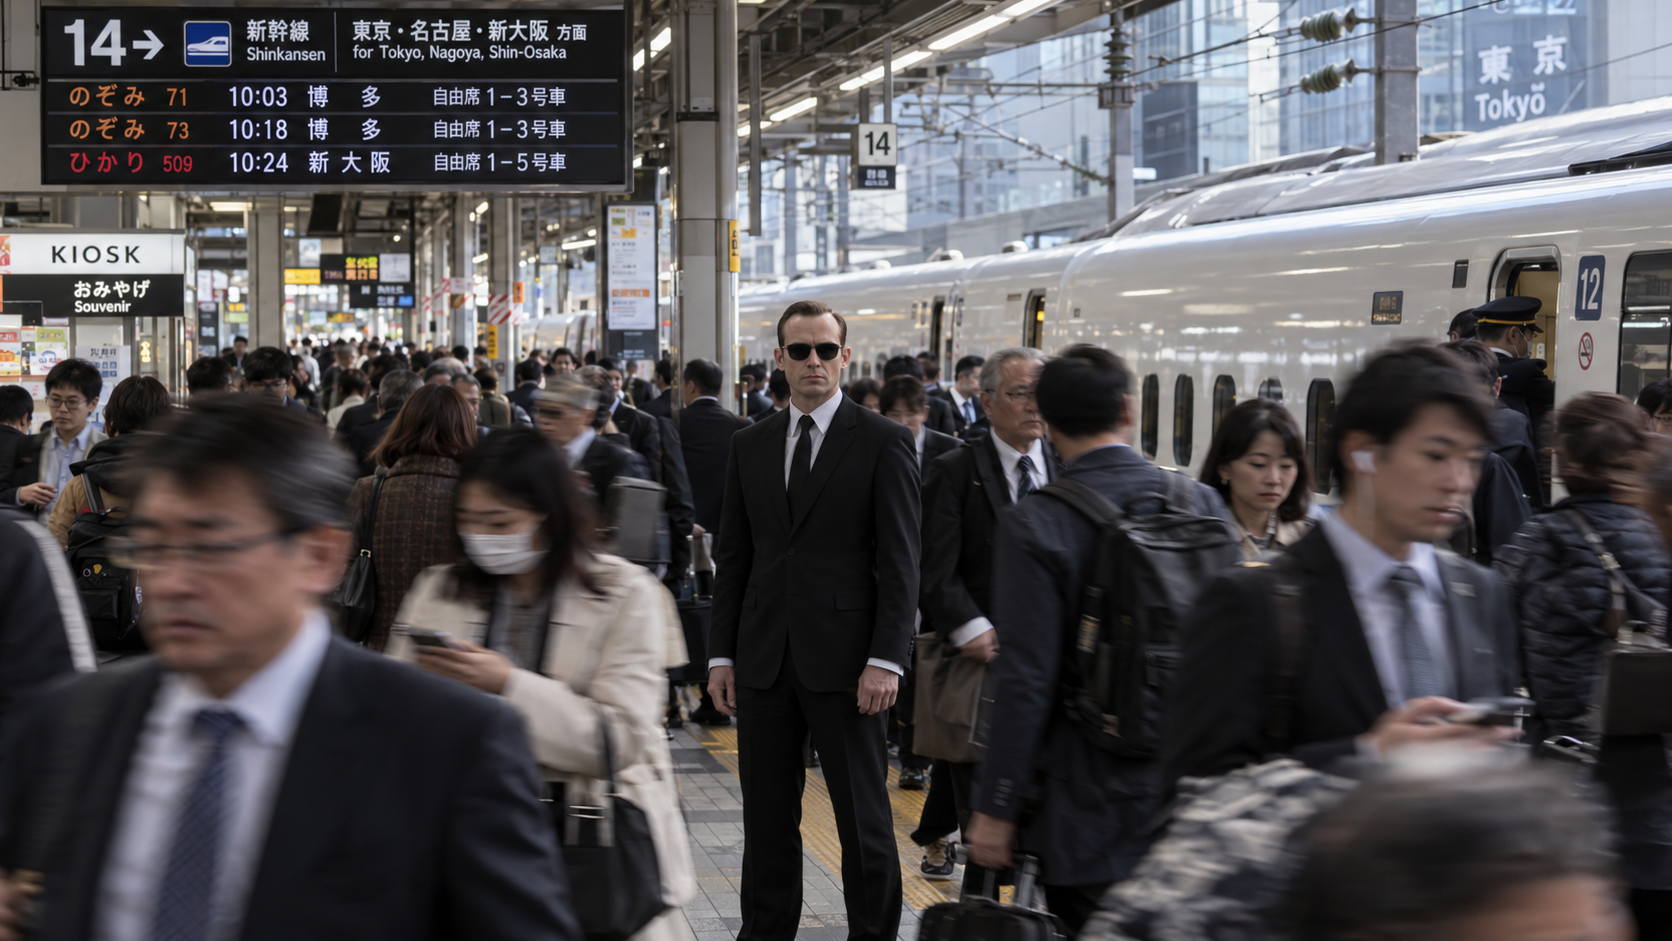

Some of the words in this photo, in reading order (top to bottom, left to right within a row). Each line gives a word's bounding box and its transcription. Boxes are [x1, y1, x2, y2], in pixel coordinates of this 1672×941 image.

[246, 19, 310, 43] 新幹線
[556, 24, 588, 42] 方面
[63, 19, 127, 67] 14
[246, 46, 326, 62] Shinkansen
[352, 45, 374, 60] for
[379, 45, 425, 63] Tokyo,
[429, 45, 485, 63] Nagoya,
[488, 45, 567, 60] Shin-Osaka
[1478, 34, 1568, 85] 東京
[69, 83, 145, 107] のぞみ
[166, 87, 187, 107] 71
[229, 85, 289, 108] 10:03
[69, 116, 145, 140] のぞみ
[166, 121, 190, 140] 73
[229, 118, 289, 140] 10:18
[865, 131, 891, 156] 14
[69, 151, 145, 174] ひかり
[163, 155, 193, 173] 509
[229, 151, 289, 173] 10:24
[52, 245, 140, 264] KIOSK
[73, 279, 151, 299] おみやげ
[1581, 267, 1601, 310] 12
[74, 300, 132, 313] Souvenir
